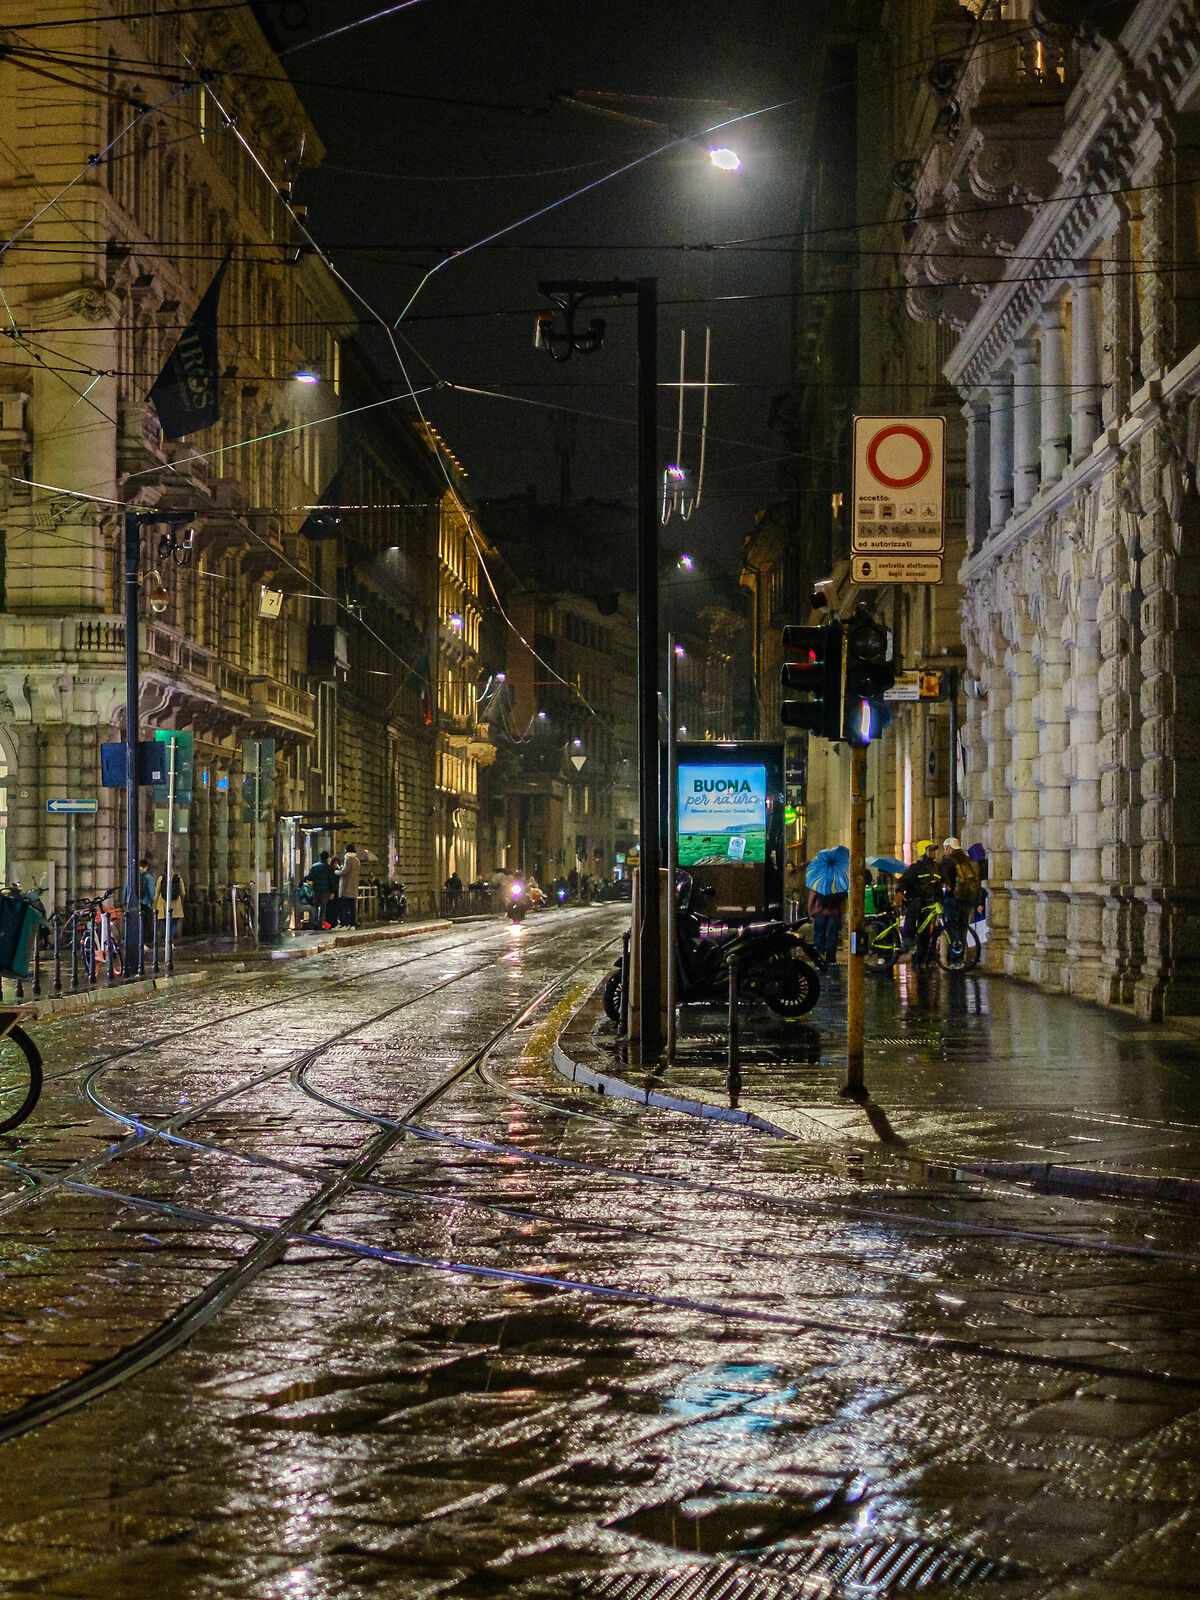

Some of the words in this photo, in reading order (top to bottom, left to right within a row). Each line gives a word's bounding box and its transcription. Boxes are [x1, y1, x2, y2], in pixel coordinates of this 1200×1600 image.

[858, 540, 868, 548] ed
[870, 540, 912, 548] autorizzati
[693, 779, 751, 793] BUONA
[684, 794, 710, 810] per
